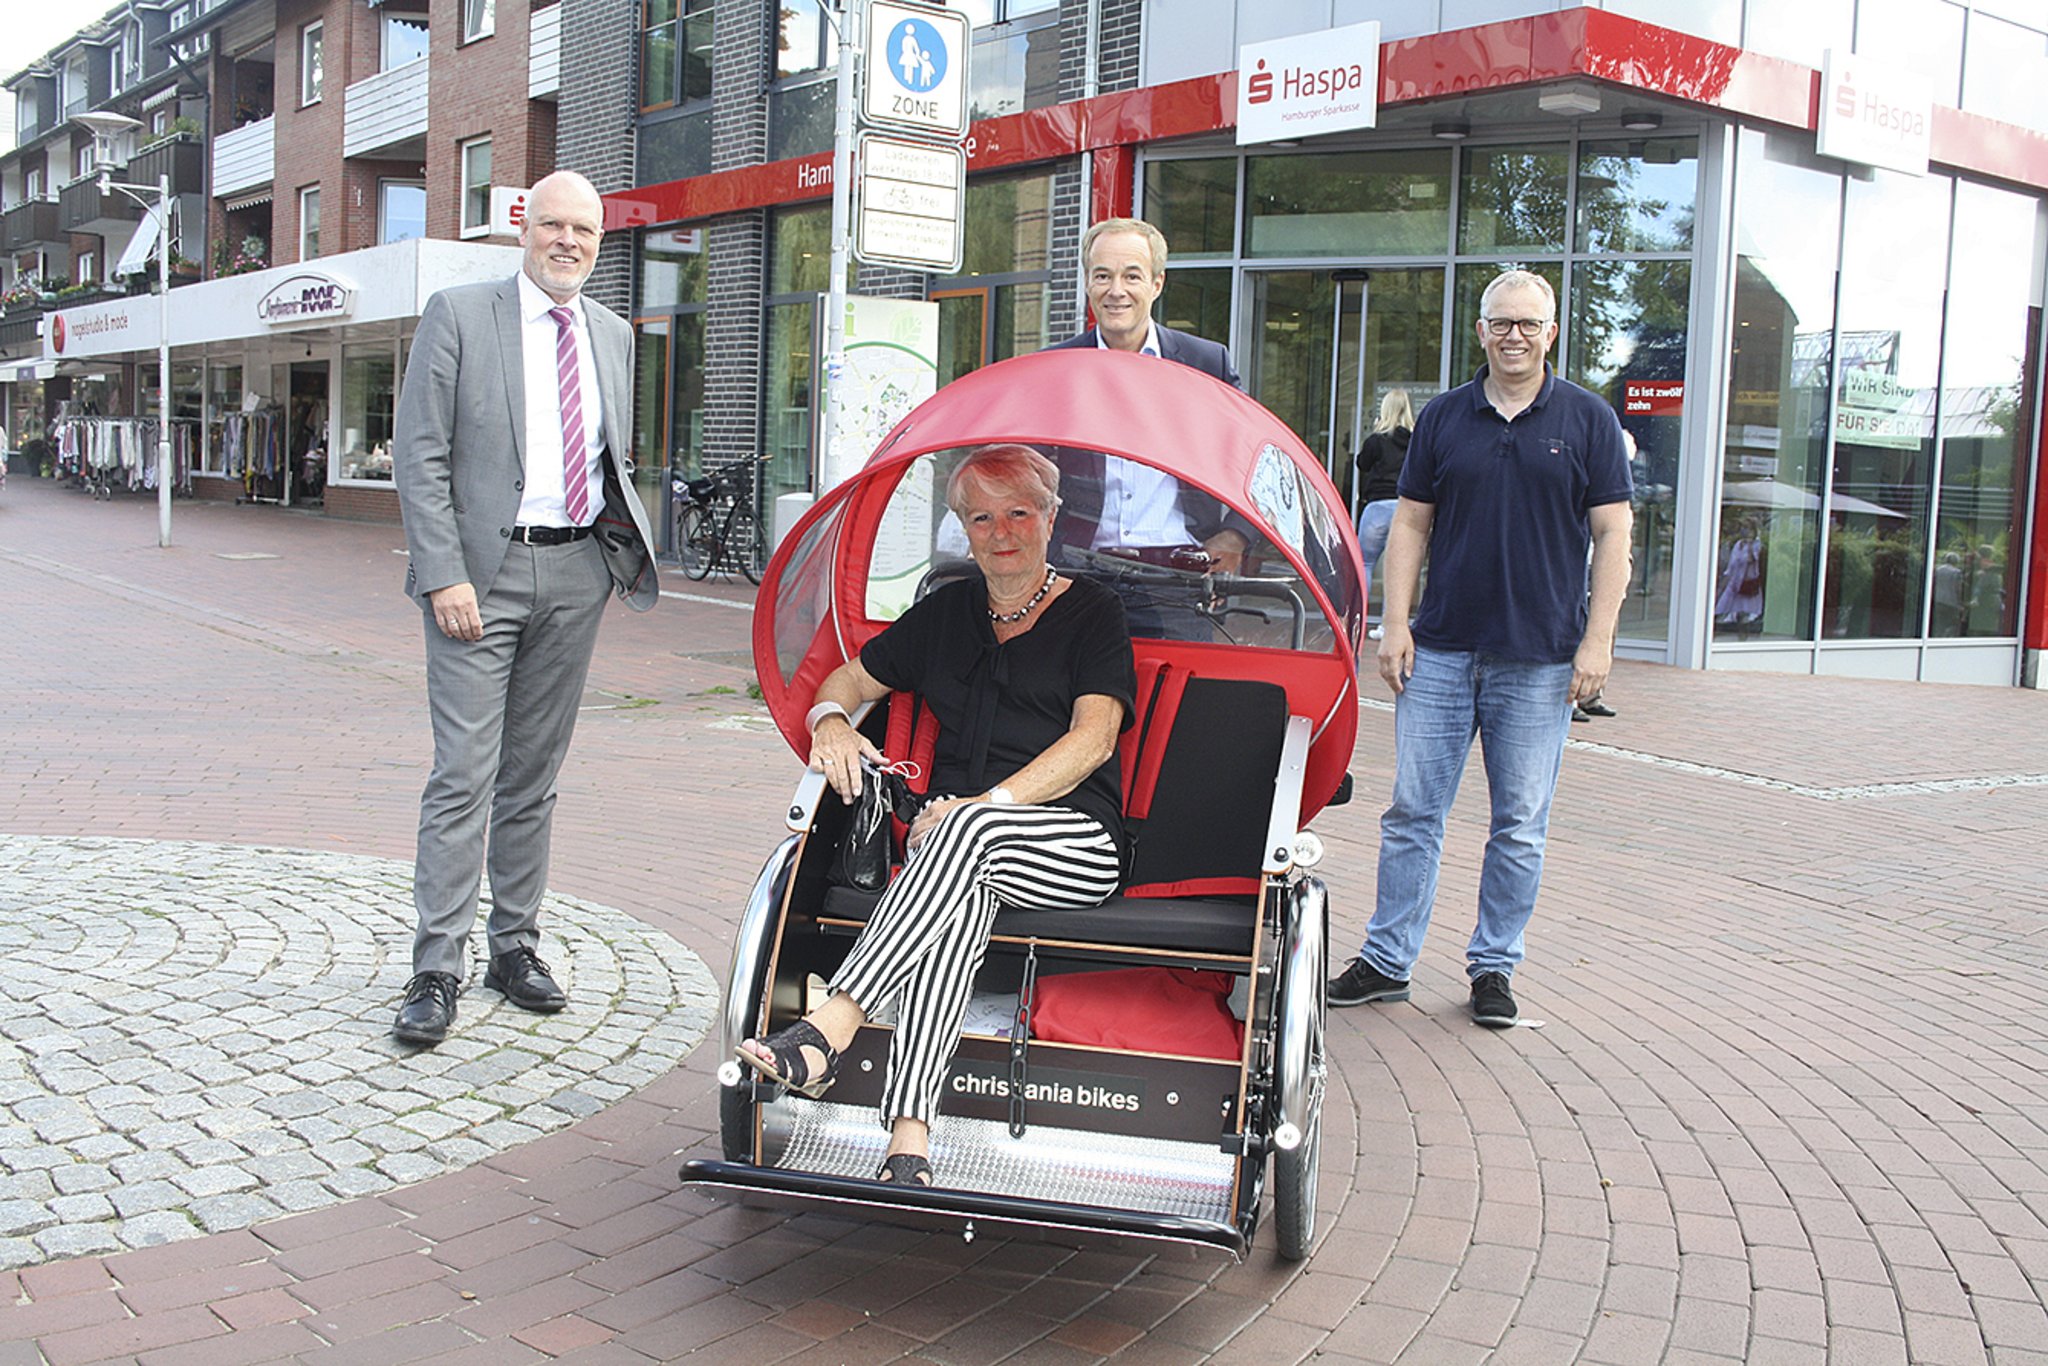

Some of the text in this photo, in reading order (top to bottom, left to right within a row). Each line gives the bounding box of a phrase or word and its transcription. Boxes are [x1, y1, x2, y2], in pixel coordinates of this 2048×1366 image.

[1283, 64, 1362, 101] Haspa
[892, 95, 939, 120] ZONE
[1281, 103, 1361, 121] Hamburger Sparkasse
[1864, 91, 1924, 140] Haspa
[110, 309, 128, 331] mode
[1628, 386, 1684, 398] Es ist zwölf
[1850, 375, 1878, 394] WIR
[1627, 400, 1652, 411] zehn
[1836, 410, 1866, 431] FÜR
[952, 1072, 1141, 1112] chrisiania bikes
